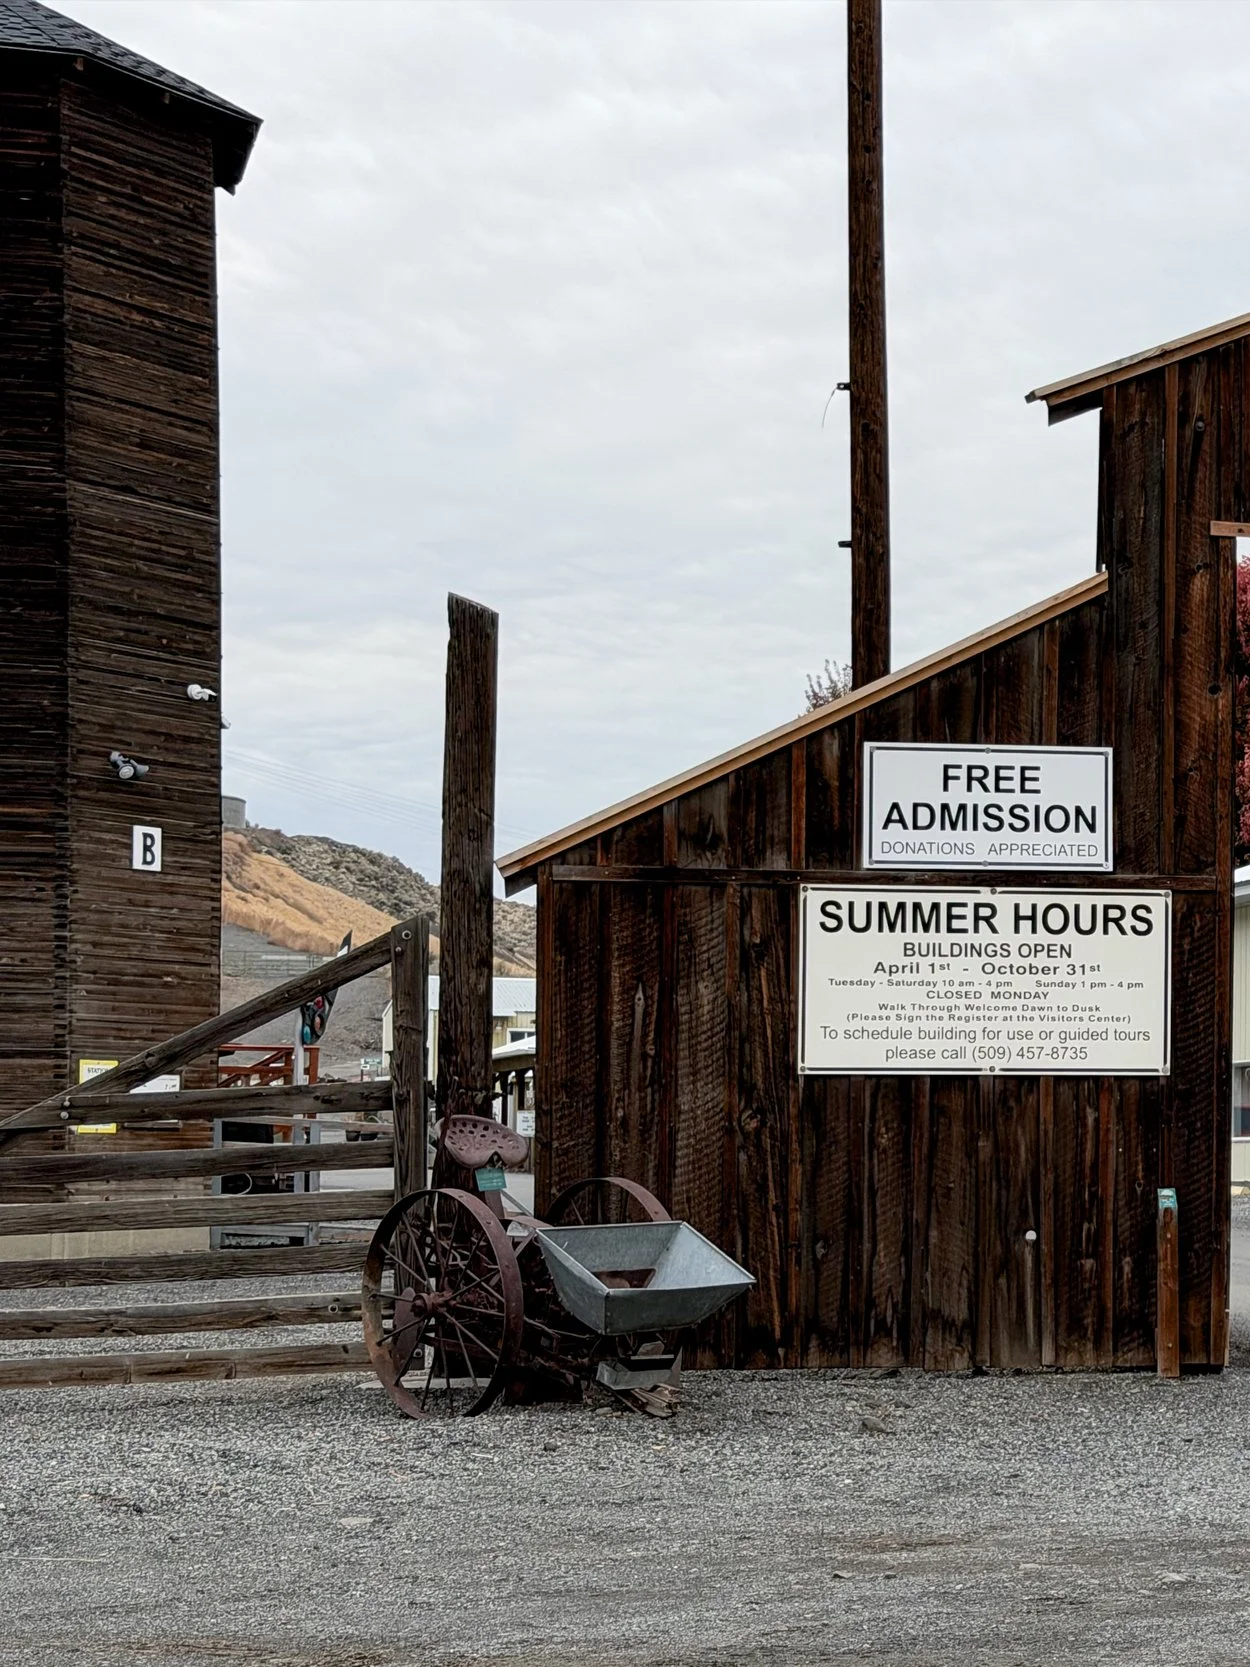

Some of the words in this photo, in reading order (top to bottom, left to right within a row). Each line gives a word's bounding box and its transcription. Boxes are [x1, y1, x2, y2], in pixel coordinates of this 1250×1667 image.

[942, 763, 1042, 795] FREE
[881, 801, 1098, 834] ADMISSION
[142, 832, 156, 866] B
[880, 841, 976, 856] DONATIONS
[987, 843, 1099, 858] APPRECIATED
[819, 899, 1000, 935] SUMMER
[1013, 901, 1154, 937] HOURS
[902, 941, 1012, 959] BUILDINGS
[1017, 942, 1073, 959] OPEN
[873, 961, 921, 977] April
[927, 962, 952, 975] 1st
[980, 962, 1061, 976] October
[1066, 963, 1102, 976] 31st
[828, 978, 876, 988] Tuesday
[886, 979, 938, 989] Saturday
[942, 980, 956, 988] 10
[985, 980, 993, 988] 4
[995, 982, 1013, 990] pm
[1035, 980, 1078, 990] Sunday
[1080, 981, 1087, 989] 1
[1090, 982, 1107, 991] pm
[1127, 983, 1145, 991] pm
[925, 990, 983, 1000] CLOSED
[990, 991, 1050, 1001] MONDAY
[878, 1003, 907, 1011] Walk
[911, 1003, 961, 1013] Through
[964, 1004, 1018, 1012] Welcome
[1071, 1005, 1102, 1013] Dusk
[846, 1013, 891, 1023] (Please
[895, 1013, 922, 1023] Sign
[925, 1014, 944, 1022] the
[948, 1014, 999, 1023] Register
[1016, 1015, 1036, 1023] the
[1038, 1015, 1085, 1023] Visitors
[1087, 1015, 1132, 1025] Center)
[819, 1025, 839, 1040] To
[843, 1026, 913, 1041] schedule
[918, 1026, 977, 1044] building
[982, 1026, 1003, 1041] for
[1006, 1030, 1034, 1042] use
[1038, 1030, 1055, 1042] or
[1058, 1028, 1109, 1044] guided
[1113, 1029, 1151, 1042] tours
[885, 1046, 937, 1063] please
[941, 1046, 967, 1060] call
[971, 1046, 1013, 1063] (509)
[1016, 1046, 1089, 1061] 457-8735
